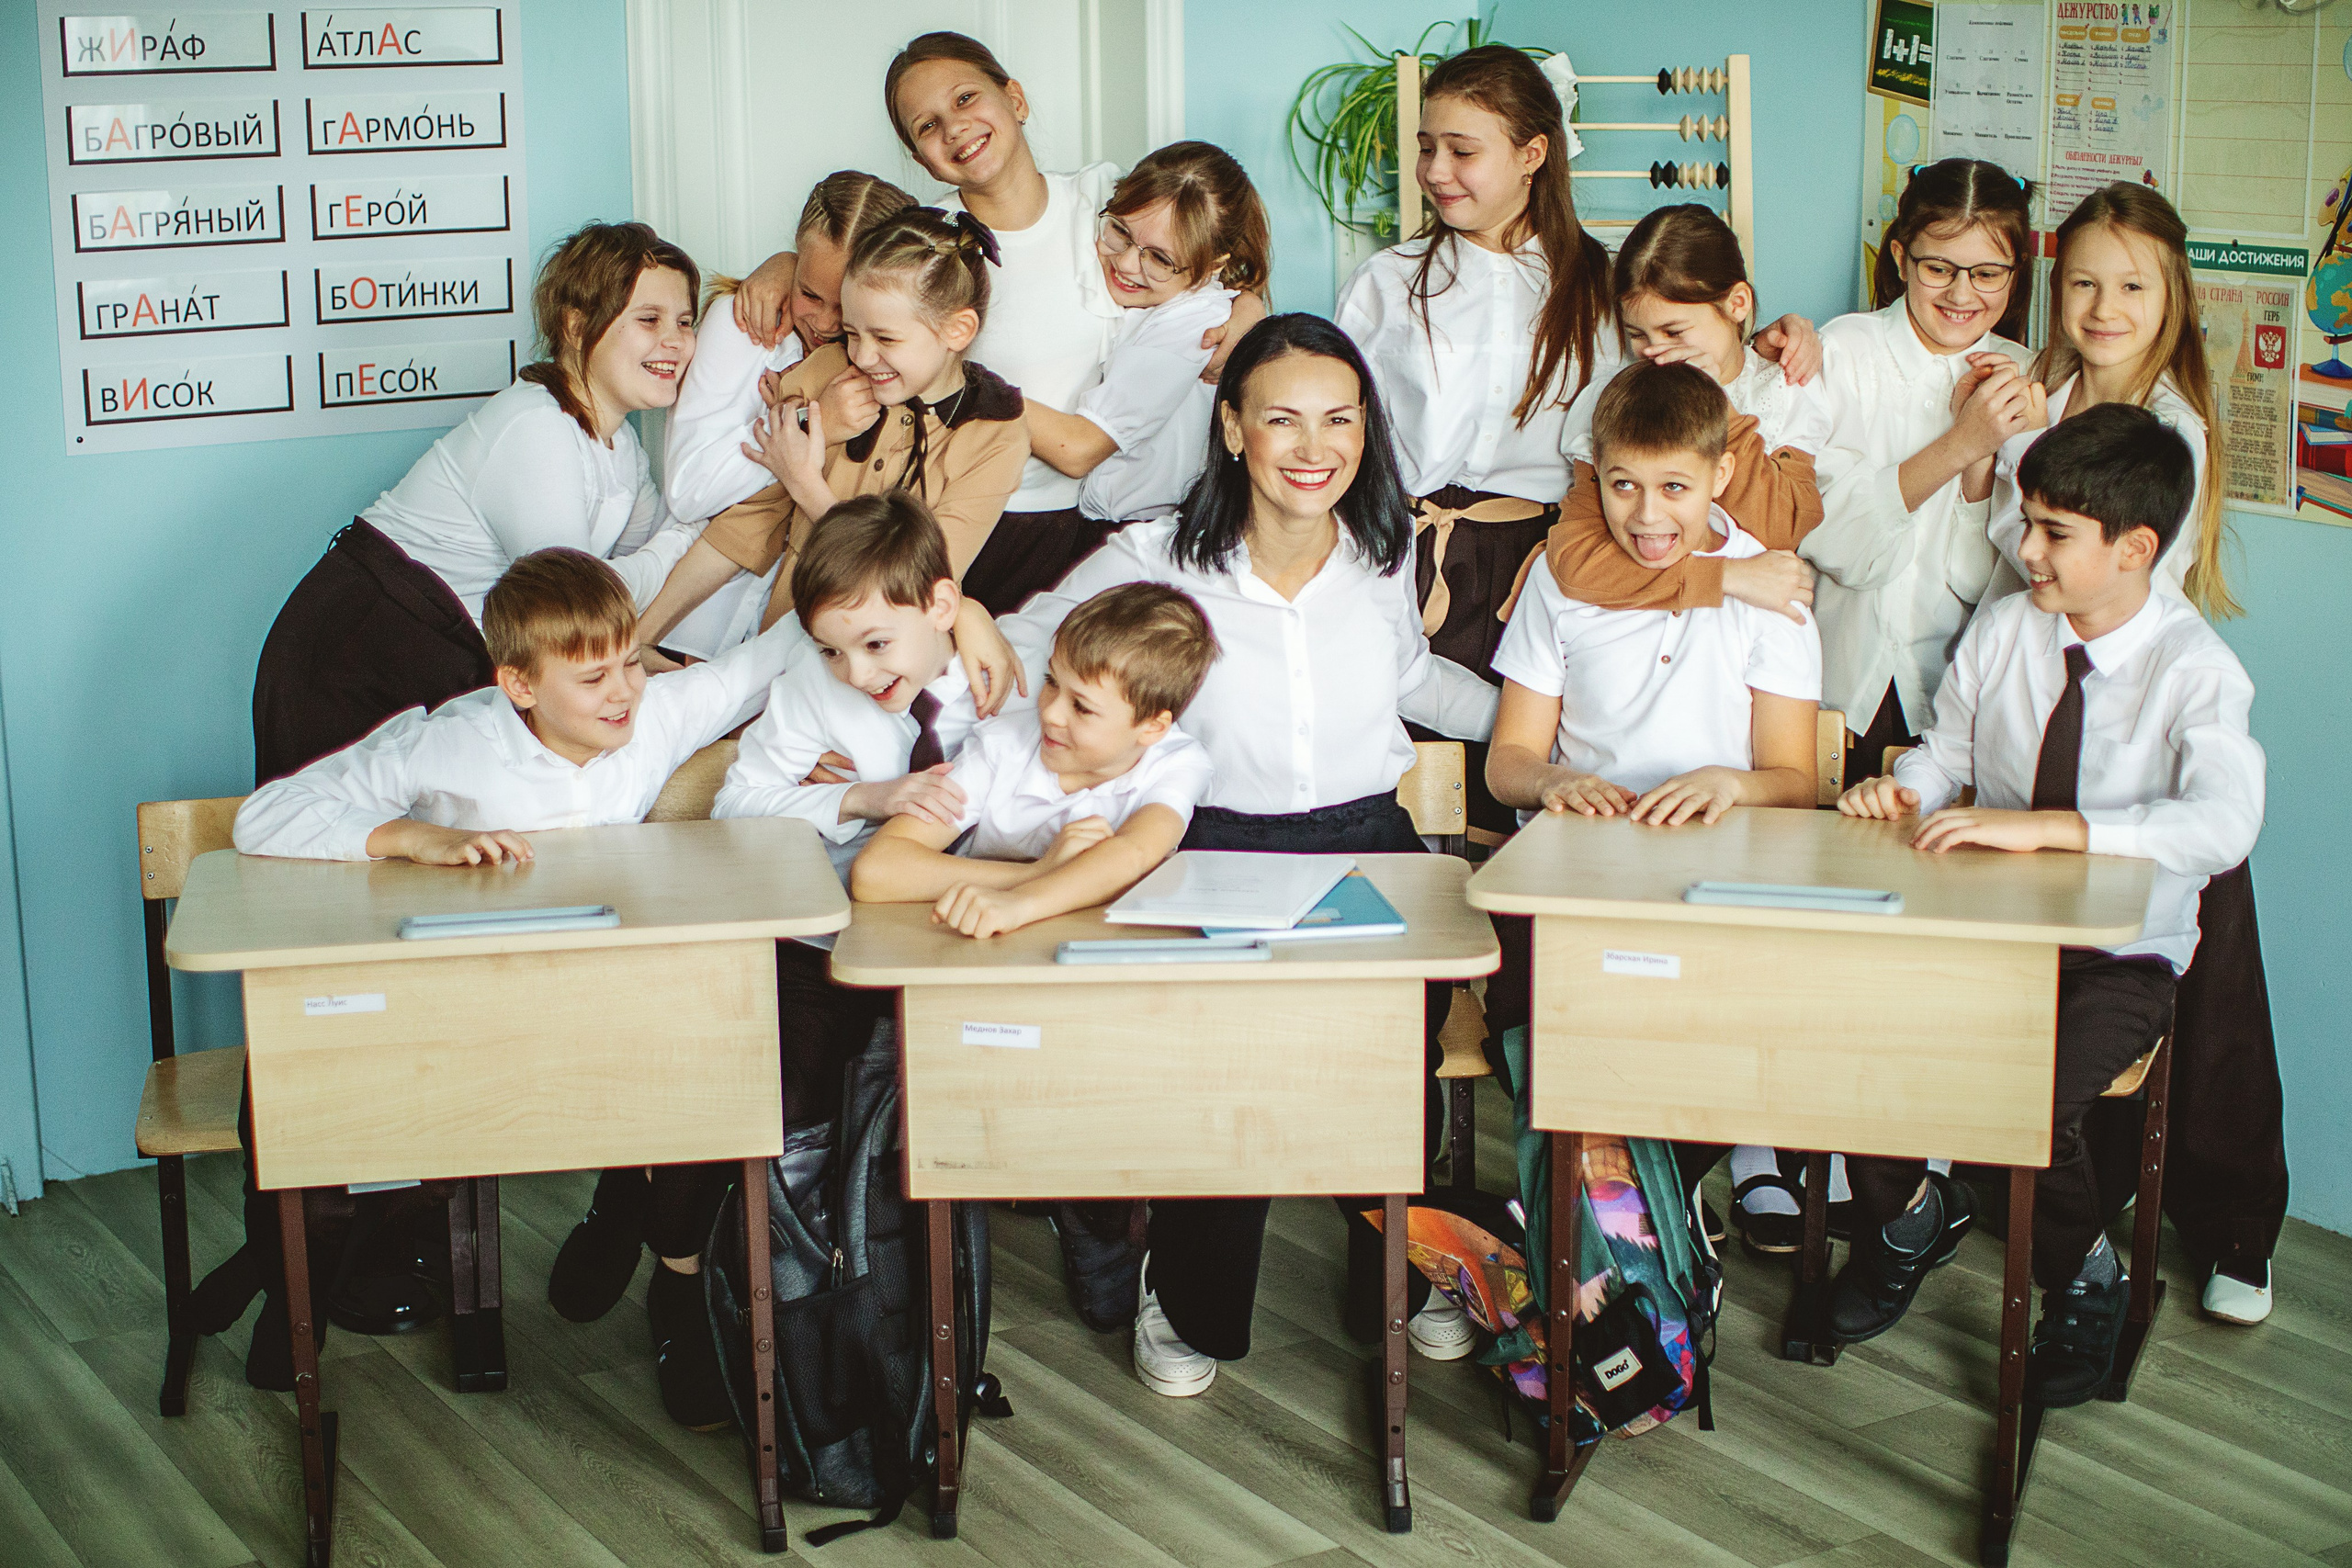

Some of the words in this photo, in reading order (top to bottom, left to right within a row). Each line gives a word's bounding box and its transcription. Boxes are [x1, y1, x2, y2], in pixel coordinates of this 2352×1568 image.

[2058, 3, 2118, 19] ДЕЖУРСТВО
[2188, 248, 2216, 262] АШИ
[2218, 251, 2304, 268] ДОСТИЖЕНИЯ
[2210, 288, 2243, 303] СТРАНА
[2256, 290, 2290, 307] РОССИЯ
[2264, 310, 2280, 321] ГЕРБ
[2246, 372, 2264, 383] ГИМН
[1643, 955, 1668, 964] Ирина
[999, 1026, 1023, 1035] Захар
[1604, 1362, 1630, 1380] DOGO
